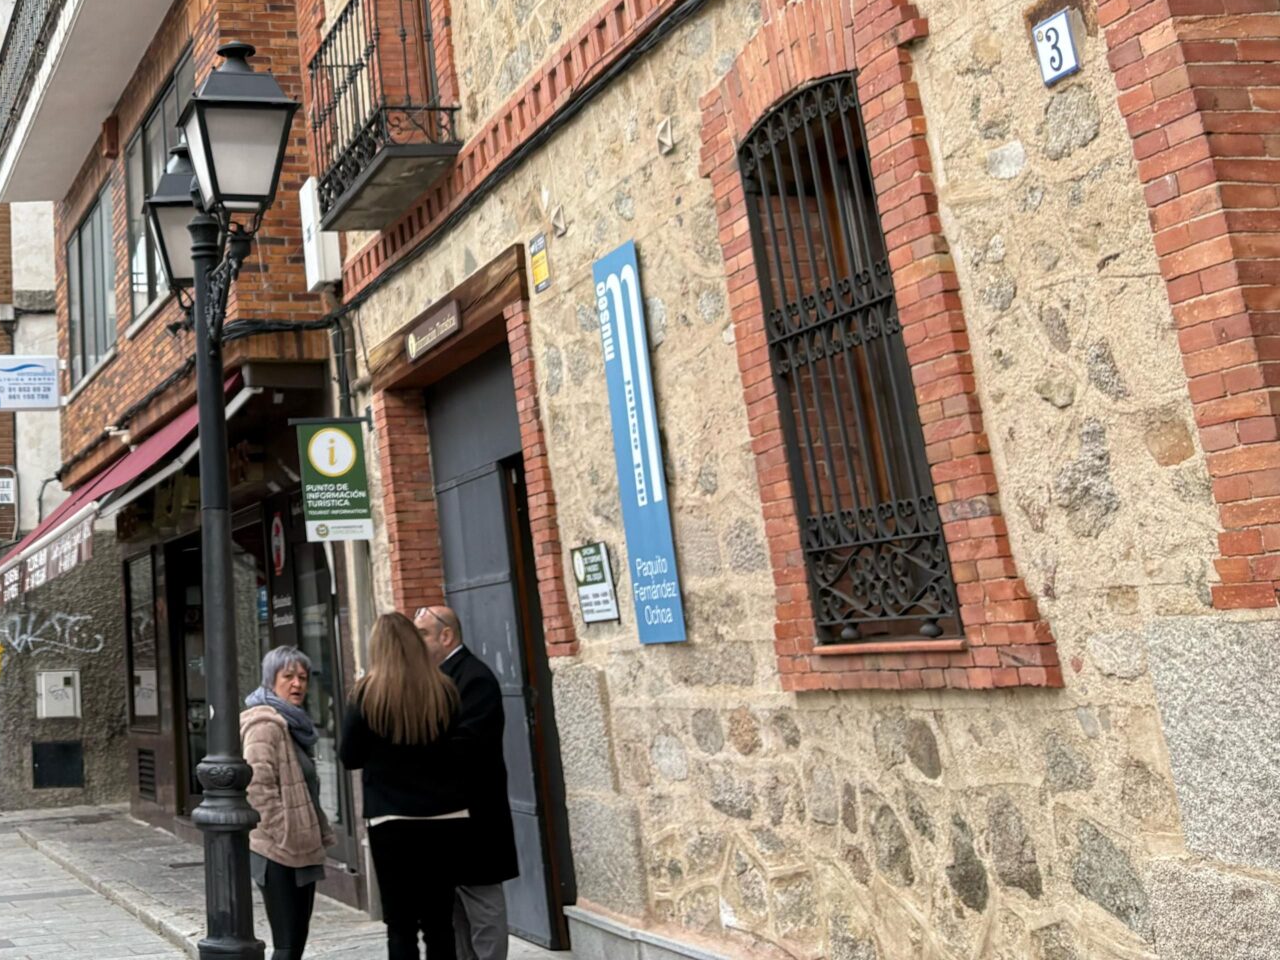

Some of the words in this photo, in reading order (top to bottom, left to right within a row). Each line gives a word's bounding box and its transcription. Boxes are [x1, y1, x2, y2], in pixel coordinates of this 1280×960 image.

[1045, 27, 1063, 72] 3
[596, 281, 615, 362] museo
[305, 484, 335, 492] PUNTO
[336, 483, 349, 491] DE
[306, 490, 366, 500] INFORMACIÓN
[636, 555, 668, 580] Paquito
[633, 579, 677, 601] Fernández
[644, 605, 673, 625] Ochoa
